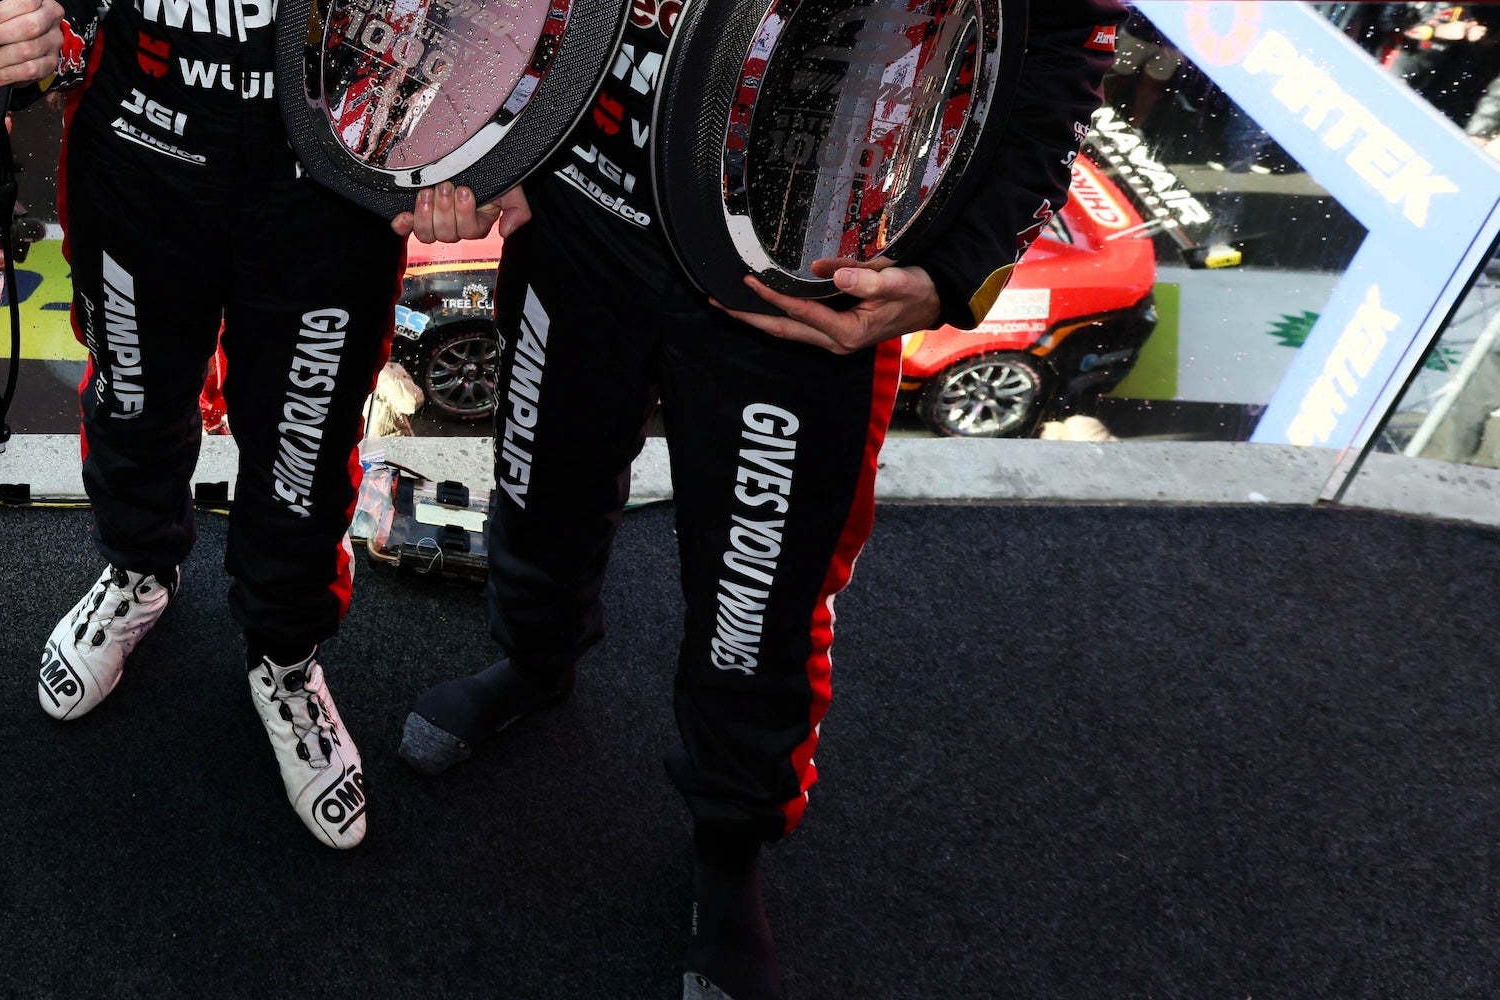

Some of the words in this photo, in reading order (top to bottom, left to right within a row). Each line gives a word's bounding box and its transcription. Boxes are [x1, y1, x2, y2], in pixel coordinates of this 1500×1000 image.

[346, 7, 455, 87] 1000
[120, 88, 188, 136] JGI
[1241, 29, 1460, 229] PIRTEK
[561, 163, 652, 226] ACDelco
[571, 142, 636, 195] JGI
[442, 299, 472, 309] TREE
[288, 307, 350, 391] GIVES
[500, 318, 547, 510] AMPLIFY
[734, 402, 800, 514] GIVES
[722, 513, 786, 586] YOU
[710, 578, 770, 677] WINGS
[40, 648, 78, 698] OMP
